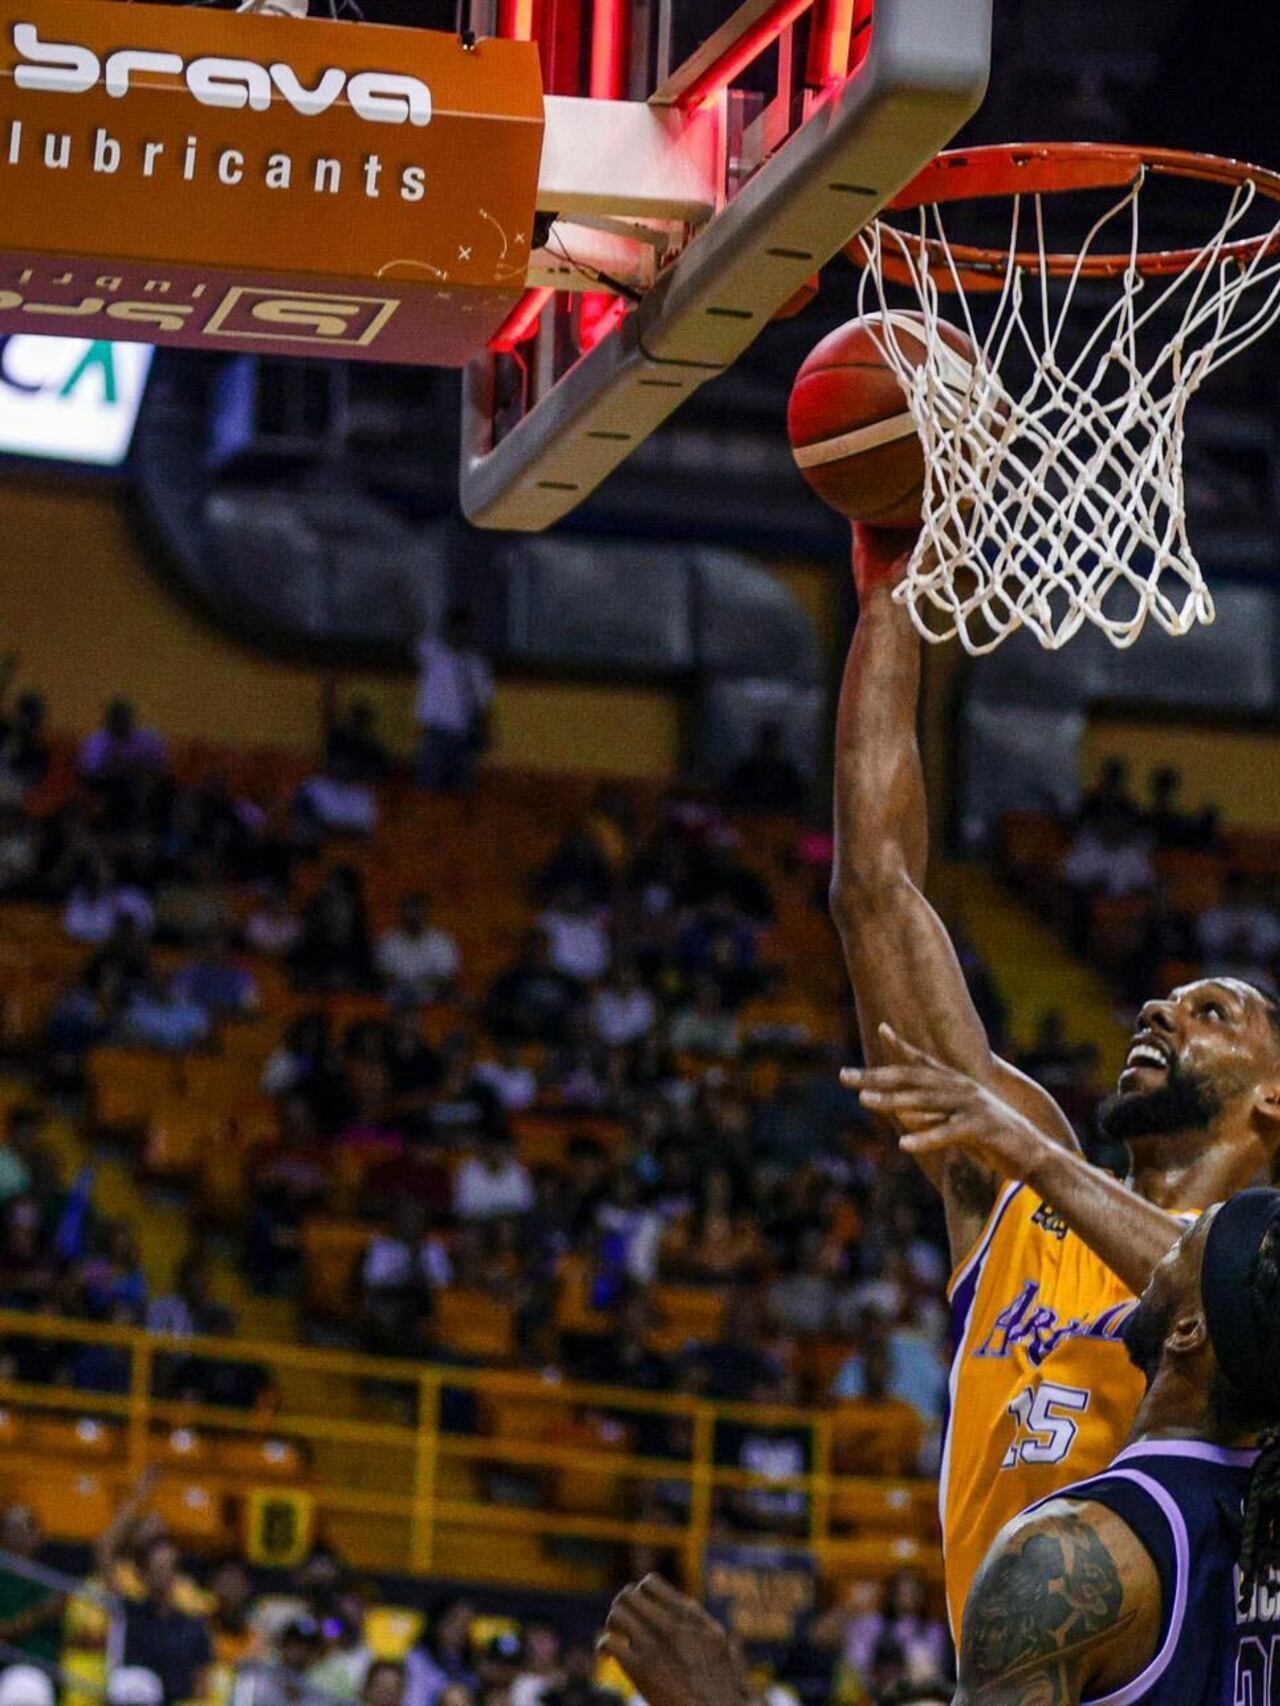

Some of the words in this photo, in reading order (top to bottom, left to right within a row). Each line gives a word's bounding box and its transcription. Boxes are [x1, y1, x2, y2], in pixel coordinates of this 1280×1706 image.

[13, 23, 433, 127] brava
[8, 120, 427, 202] lubricants
[0, 289, 195, 332] br
